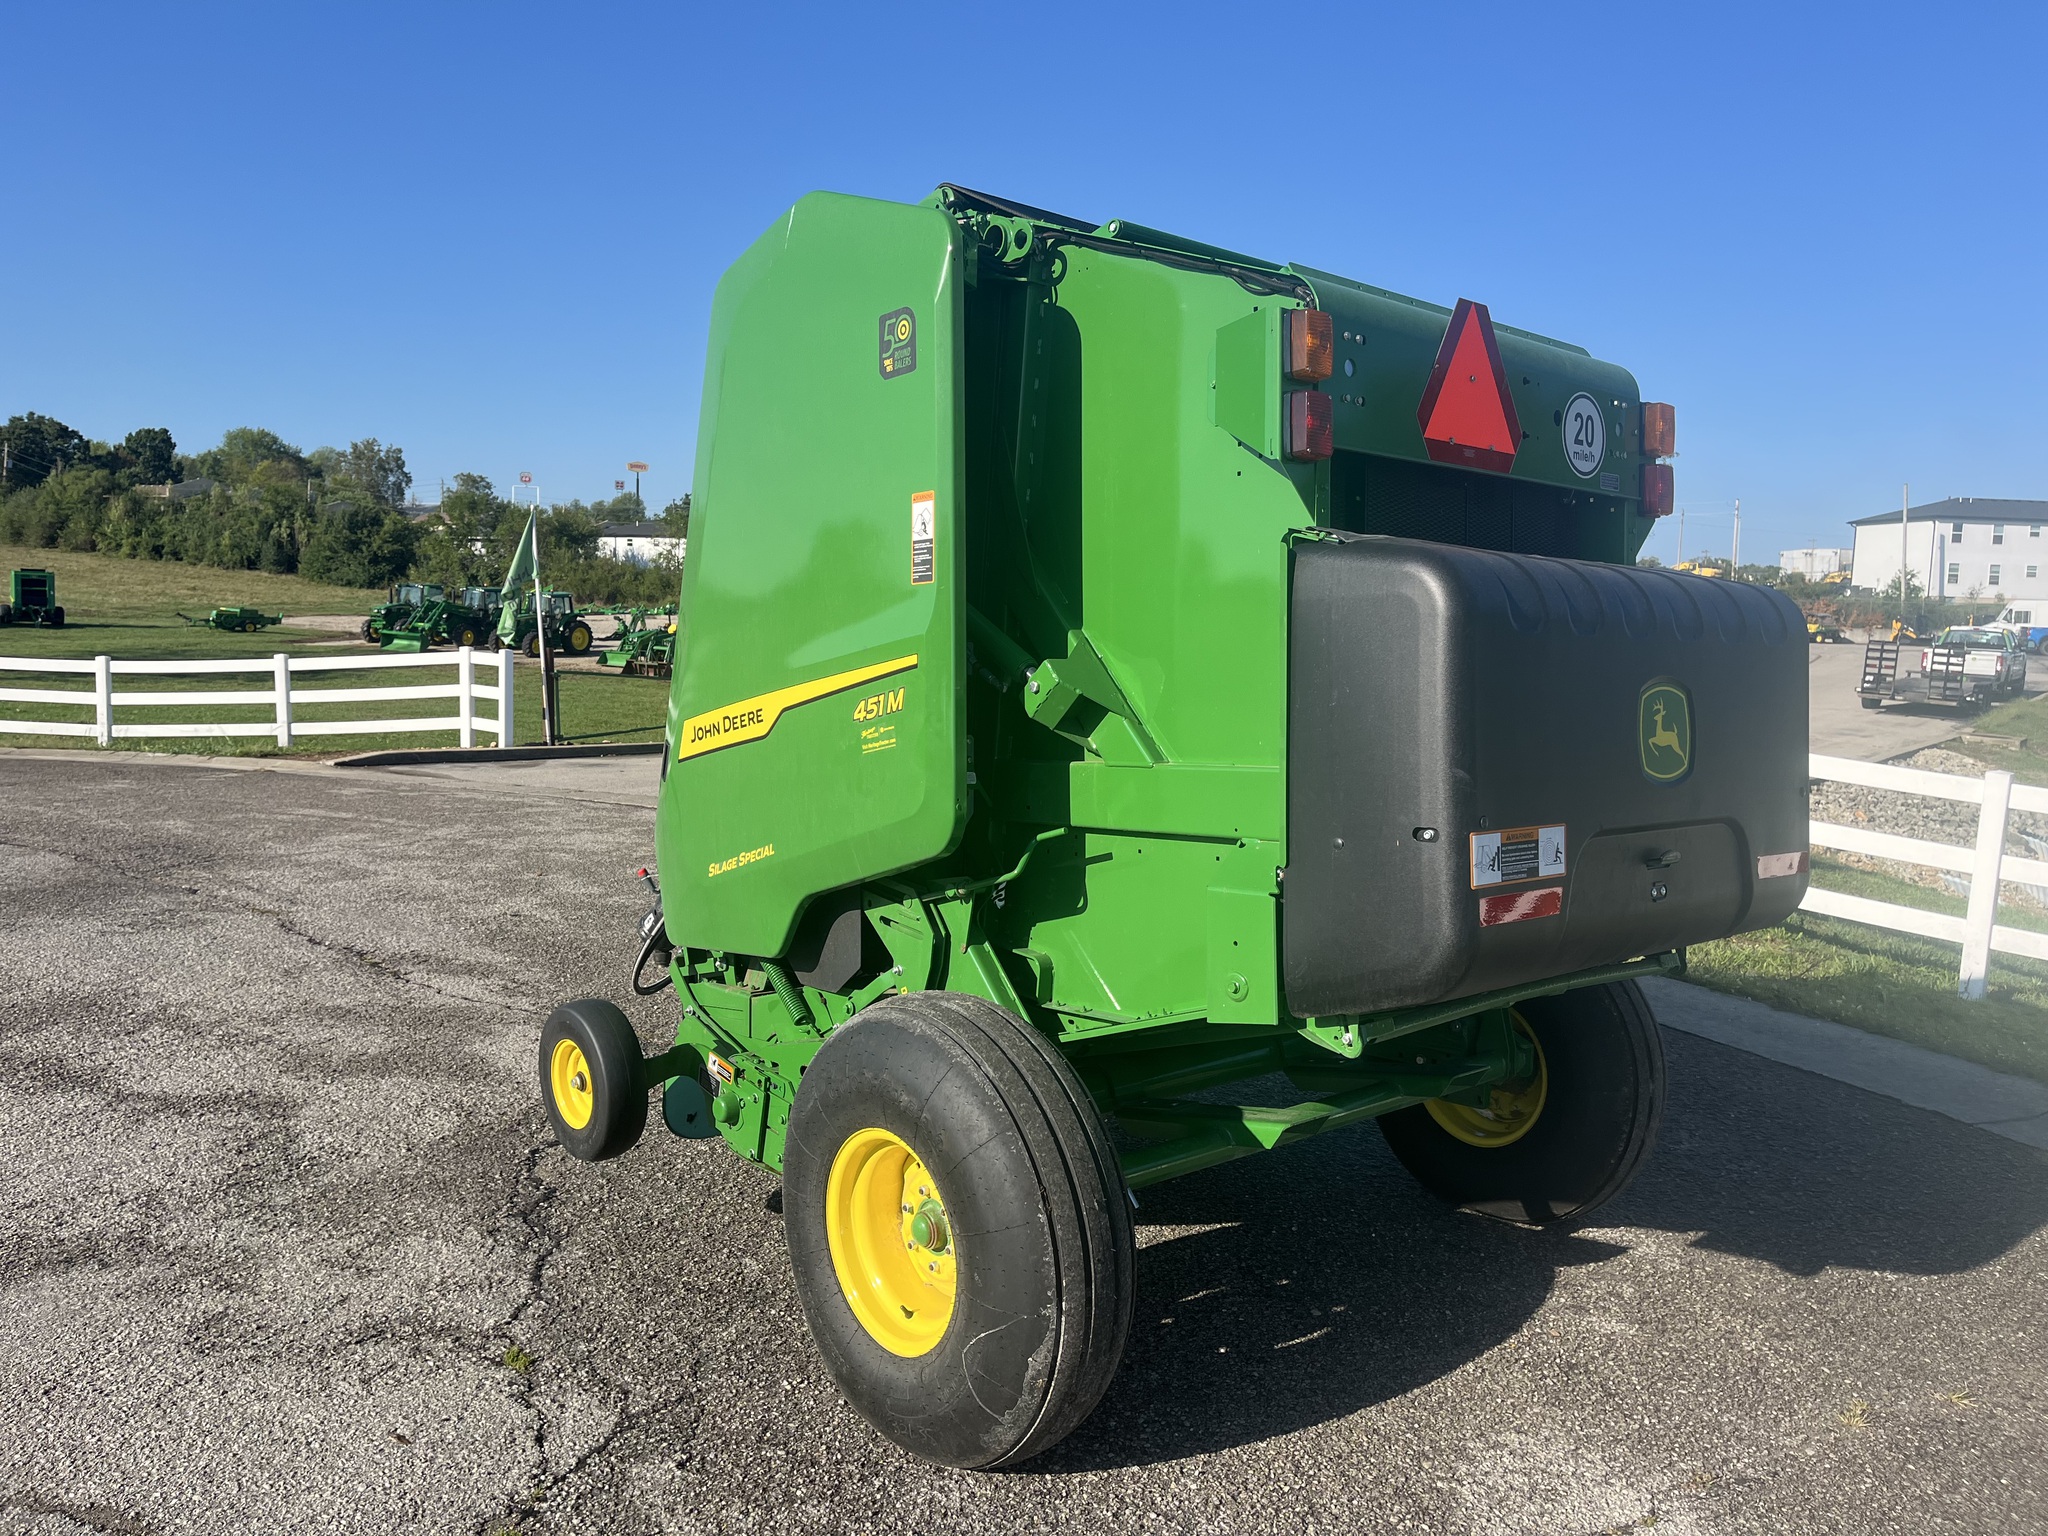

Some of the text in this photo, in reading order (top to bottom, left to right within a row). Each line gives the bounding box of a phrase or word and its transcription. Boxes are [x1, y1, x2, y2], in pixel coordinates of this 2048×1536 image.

[882, 314, 912, 358] 50
[1573, 412, 1595, 448] 20
[1573, 449, 1595, 464] mile/h
[691, 708, 764, 744] JOHN DEERE
[708, 843, 775, 878] SILAGE SPECIAL
